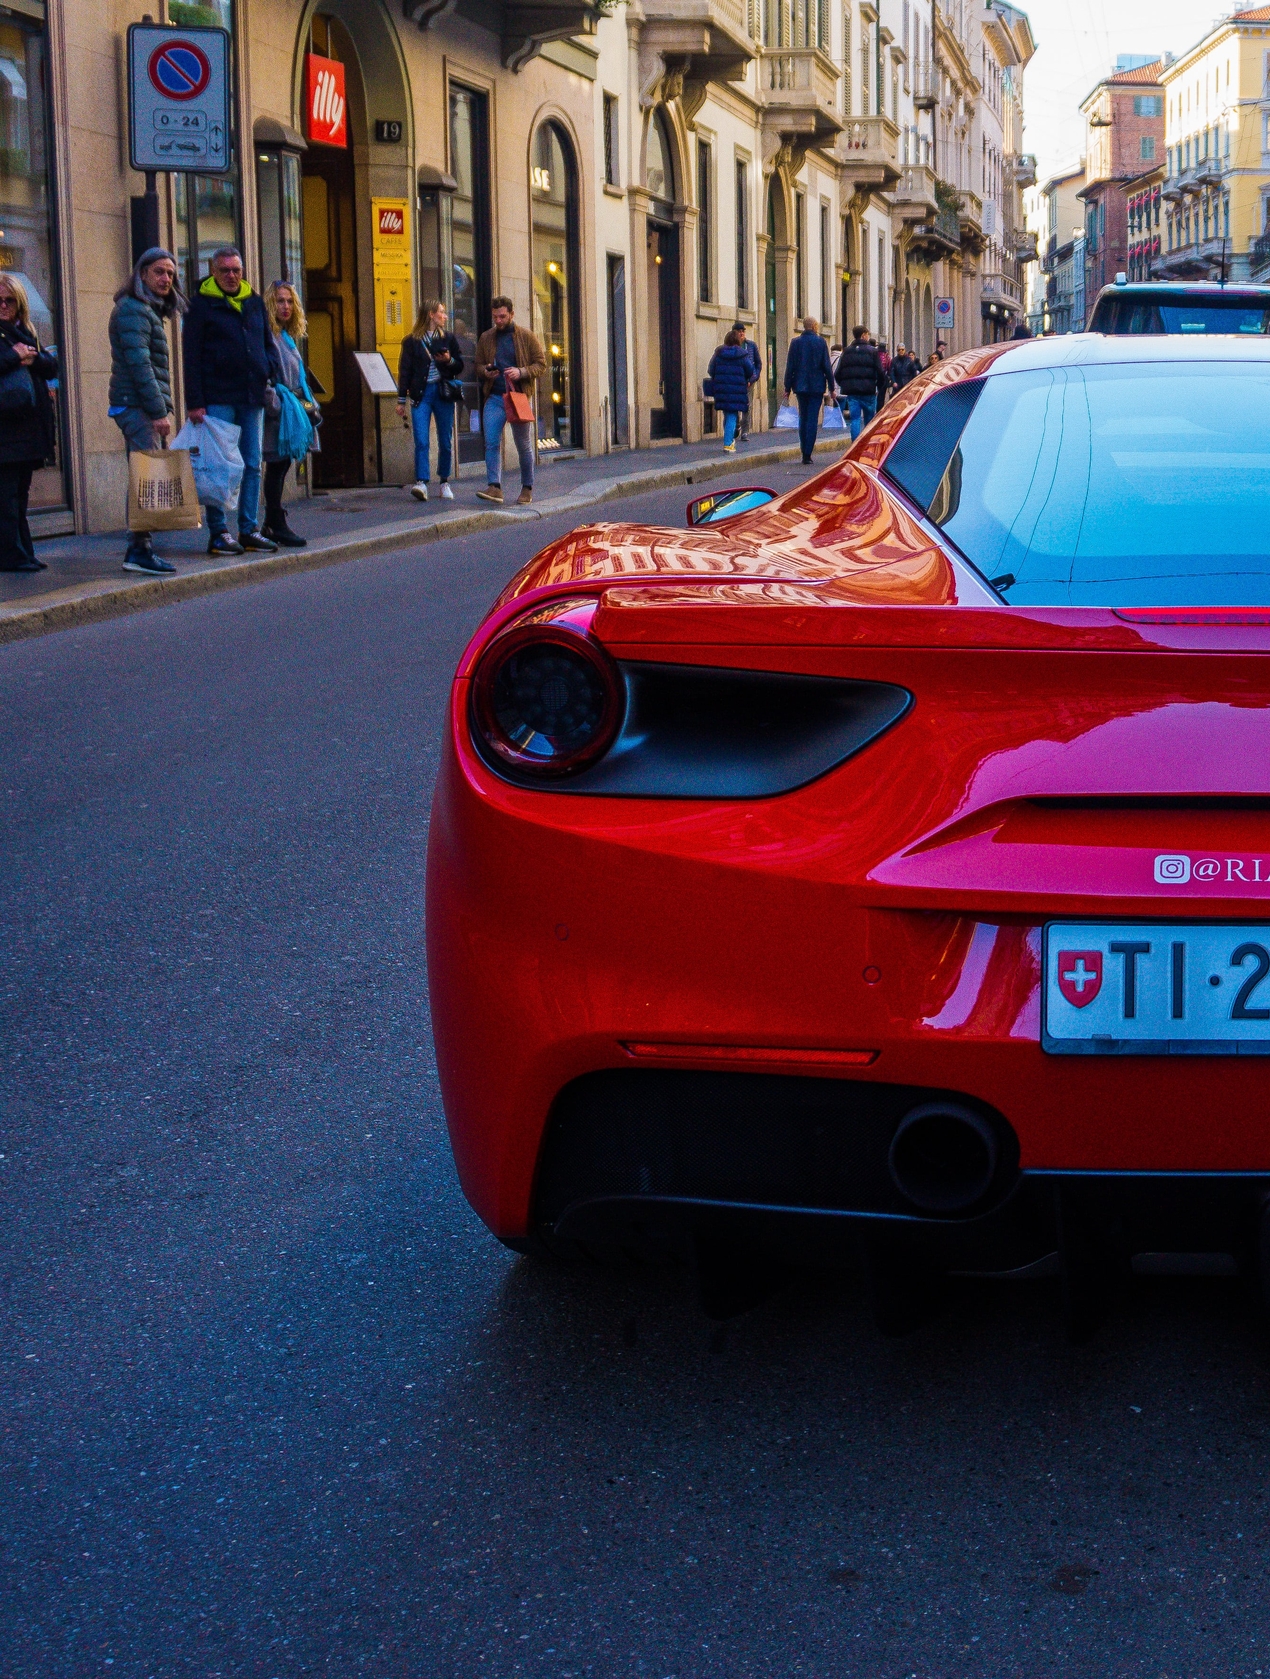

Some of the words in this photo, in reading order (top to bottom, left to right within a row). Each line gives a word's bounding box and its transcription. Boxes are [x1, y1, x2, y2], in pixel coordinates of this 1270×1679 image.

[313, 70, 344, 136] illy
[161, 114, 170, 125] 0
[182, 116, 200, 127] 24
[383, 122, 400, 140] 19
[380, 211, 402, 233] illy
